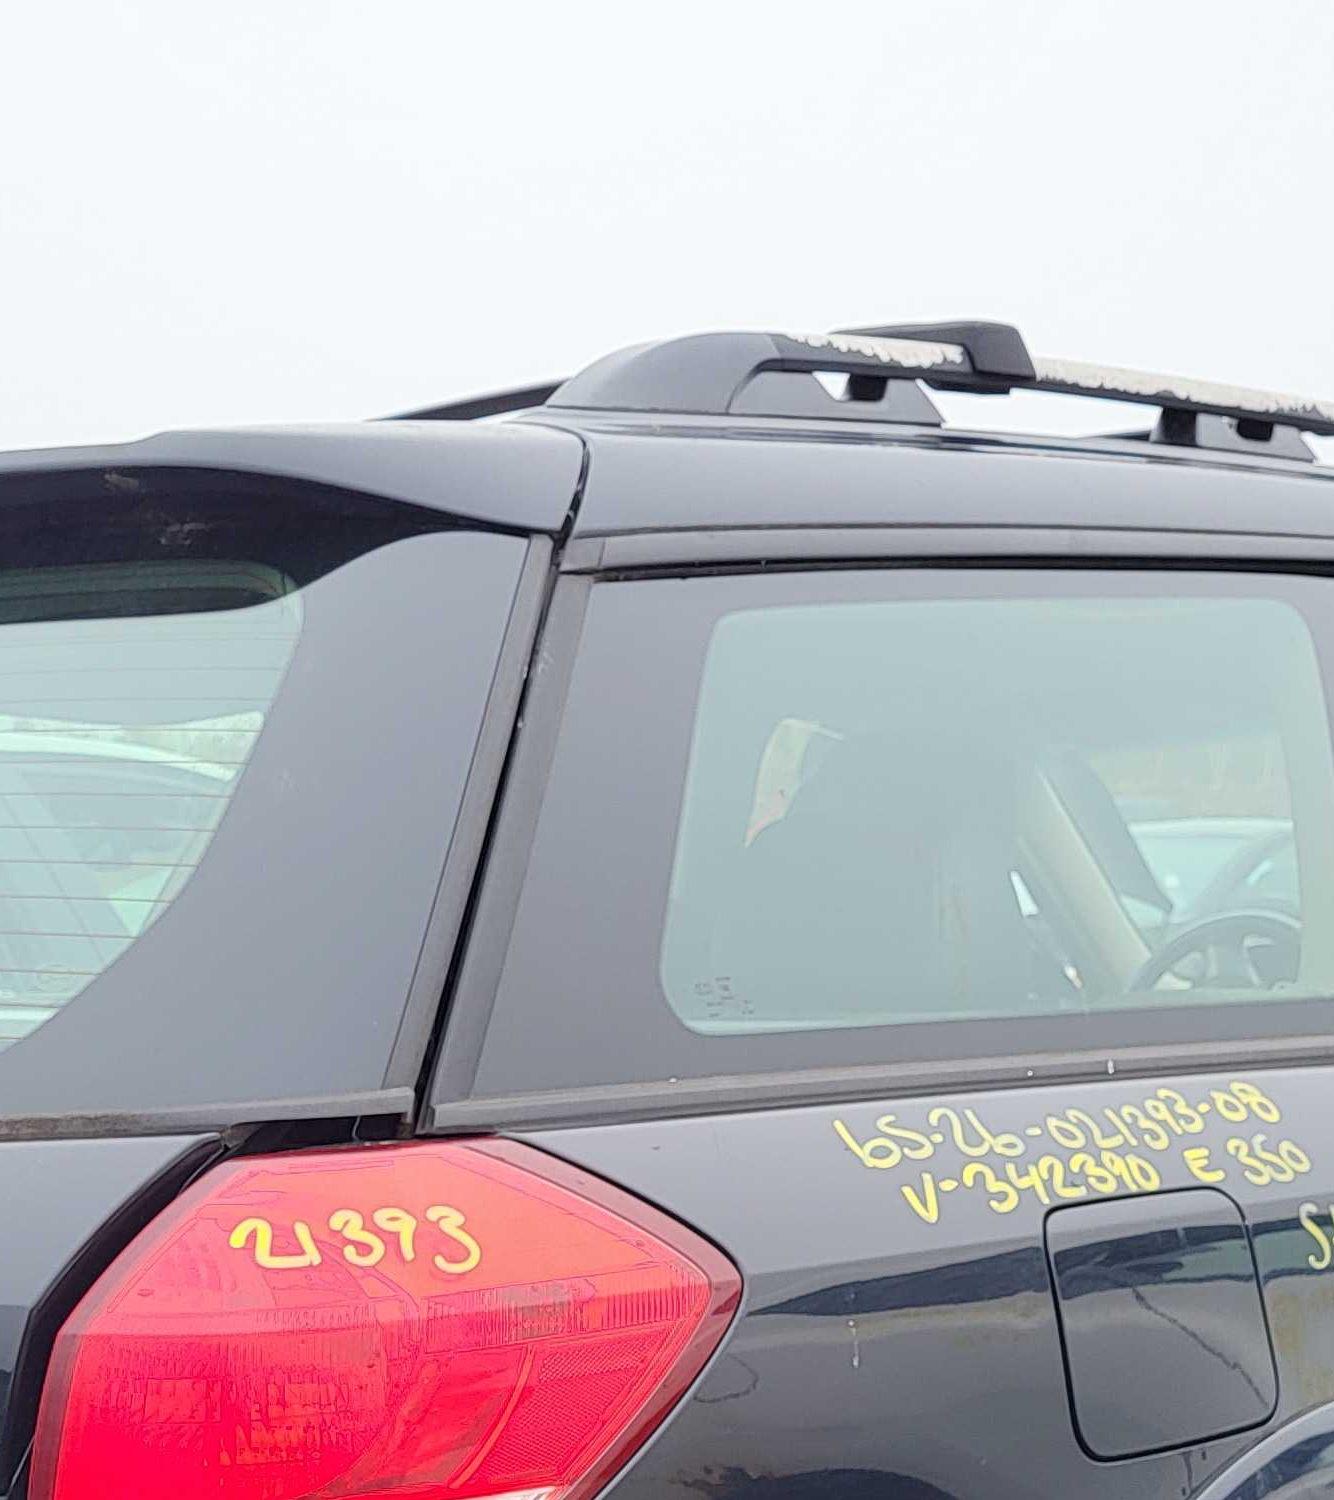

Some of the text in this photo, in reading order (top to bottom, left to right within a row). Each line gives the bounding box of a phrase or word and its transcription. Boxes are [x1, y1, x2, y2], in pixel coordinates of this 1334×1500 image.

[1183, 1146, 1225, 1184] E
[1227, 1133, 1313, 1187] 350
[228, 1204, 482, 1275] 21393
